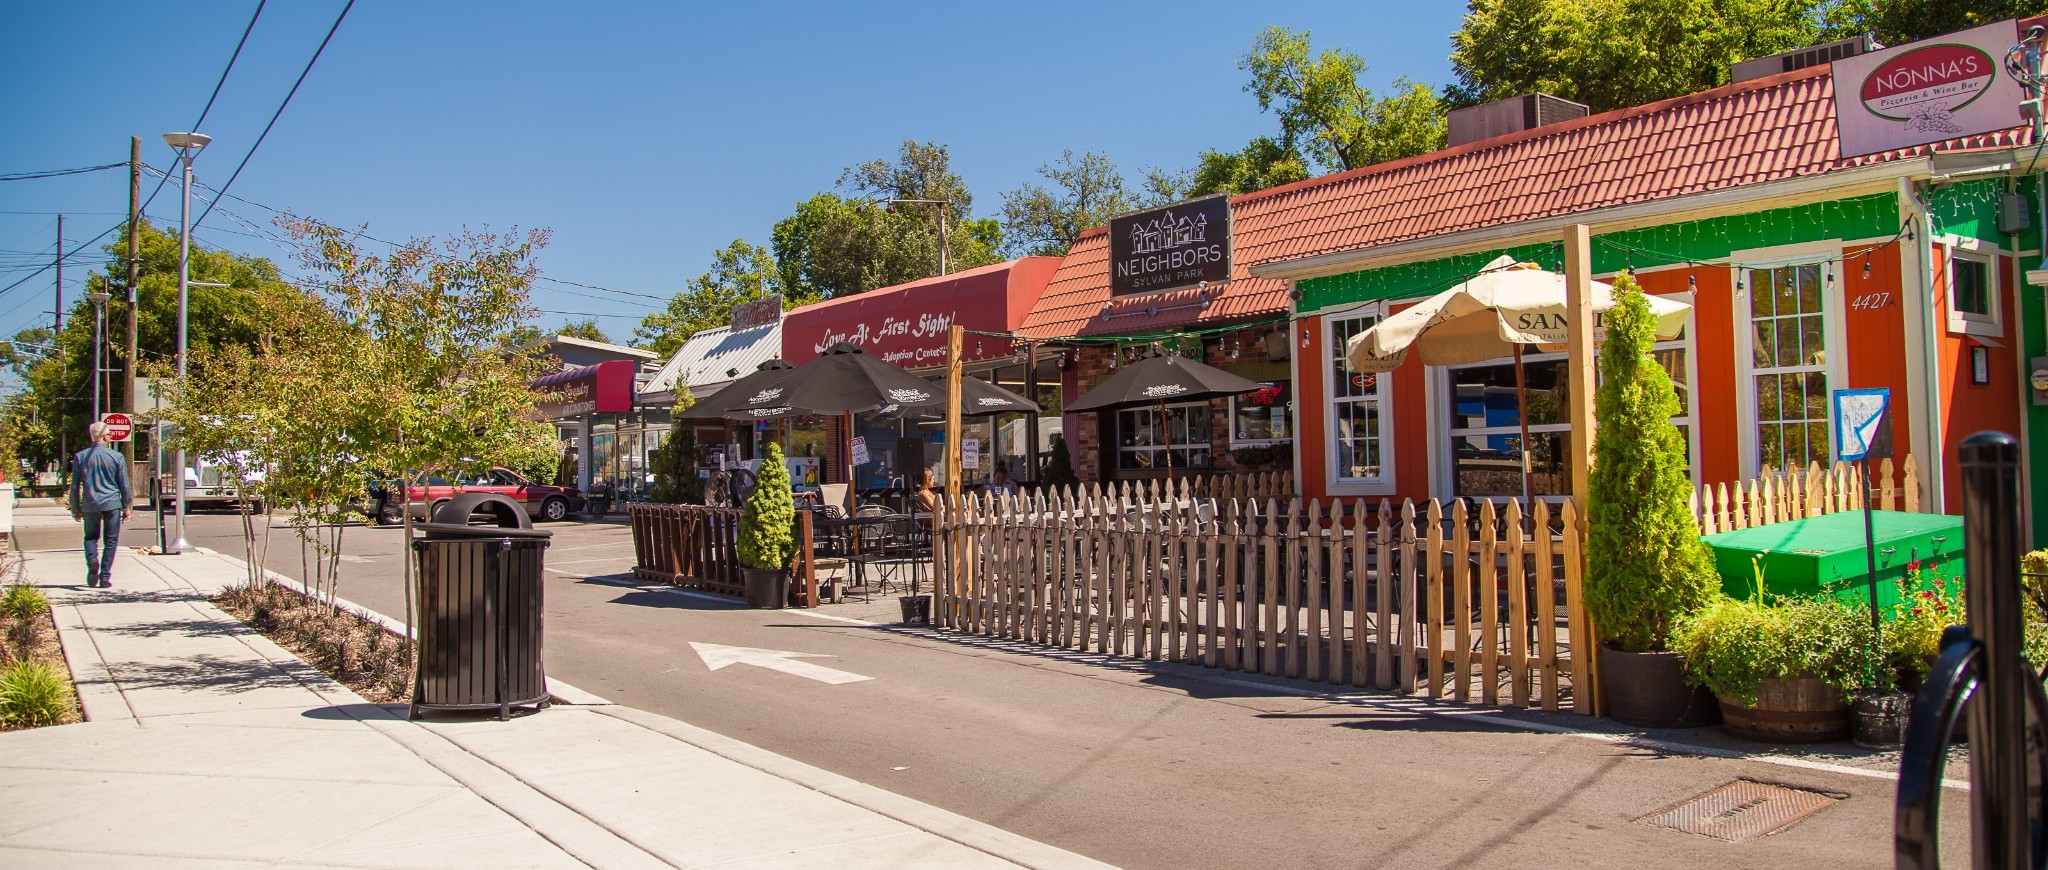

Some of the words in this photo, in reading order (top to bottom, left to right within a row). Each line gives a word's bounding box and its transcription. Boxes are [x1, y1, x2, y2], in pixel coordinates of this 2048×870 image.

[1881, 93, 1919, 106] Pizzeria
[1934, 85, 1956, 96] Wine
[1961, 81, 1979, 90] Bar
[1118, 245, 1221, 278] NEIGHBORS
[1132, 273, 1171, 288] SYLVAN
[1177, 268, 1204, 280] PARK
[1852, 292, 1889, 310] 4427
[815, 328, 846, 353] Love
[849, 323, 870, 345] At
[872, 317, 910, 343] First
[882, 352, 913, 364] Adoption
[916, 346, 939, 361] Center
[1252, 396, 1274, 405] OPEN
